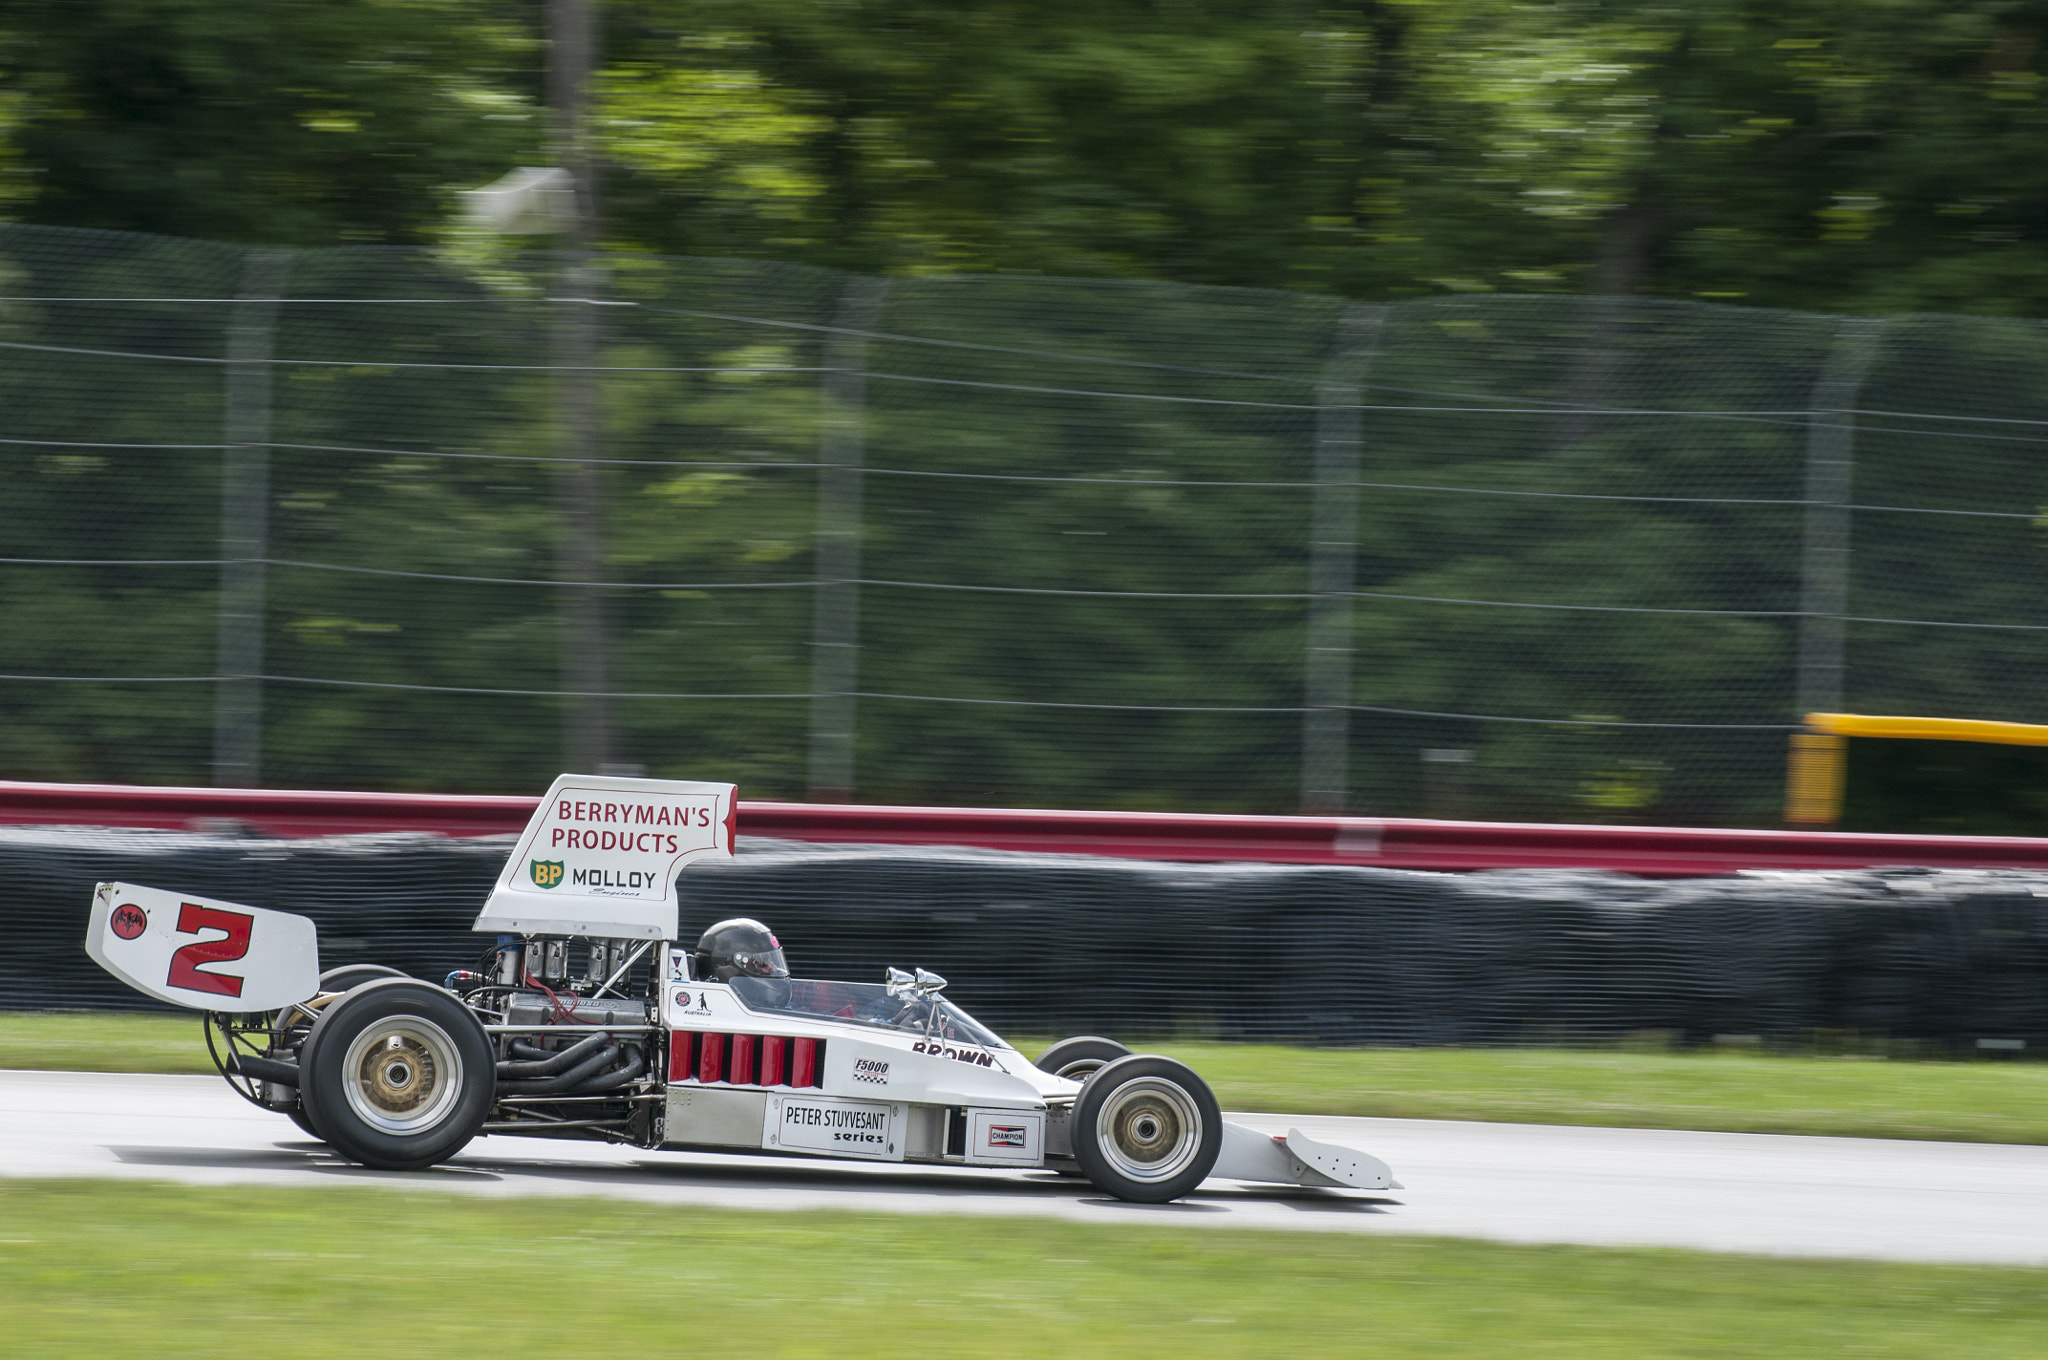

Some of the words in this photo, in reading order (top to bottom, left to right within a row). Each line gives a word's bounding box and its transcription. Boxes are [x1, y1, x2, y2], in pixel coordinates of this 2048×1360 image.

[558, 801, 710, 827] BERRYMAN'S
[551, 828, 678, 853] PRODUCTS
[535, 864, 562, 885] BP
[573, 868, 656, 889] MOLLOY
[166, 902, 254, 998] 2
[855, 1059, 889, 1073] F5000
[786, 1106, 821, 1126] PETER
[824, 1109, 885, 1130] STUYVESANT
[833, 1132, 884, 1144] series
[992, 1132, 1023, 1141] CHAMPION
